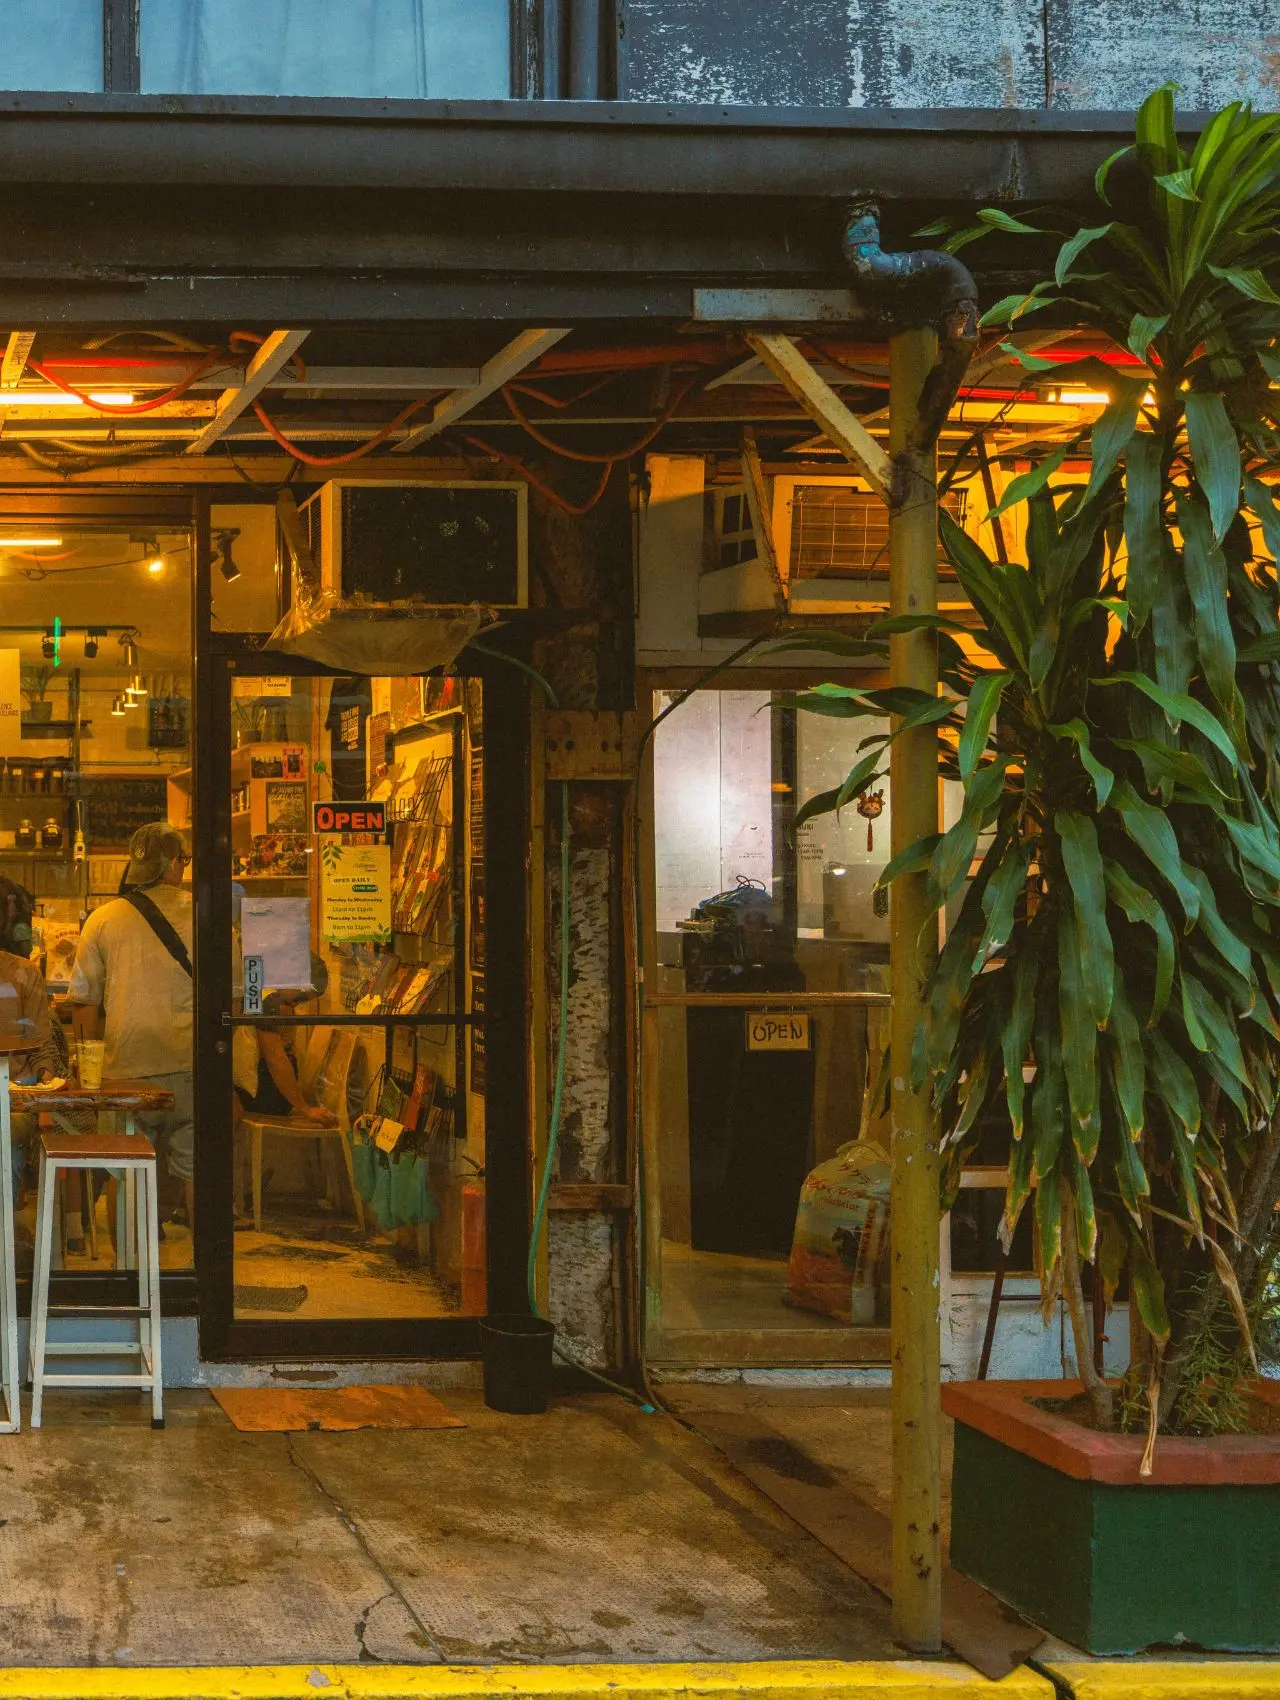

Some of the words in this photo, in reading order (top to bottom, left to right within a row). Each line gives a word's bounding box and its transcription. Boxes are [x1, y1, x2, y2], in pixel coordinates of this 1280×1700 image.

[317, 807, 383, 829] OPEN
[248, 960, 259, 1008] PUSH
[753, 1020, 802, 1042] OPEN
